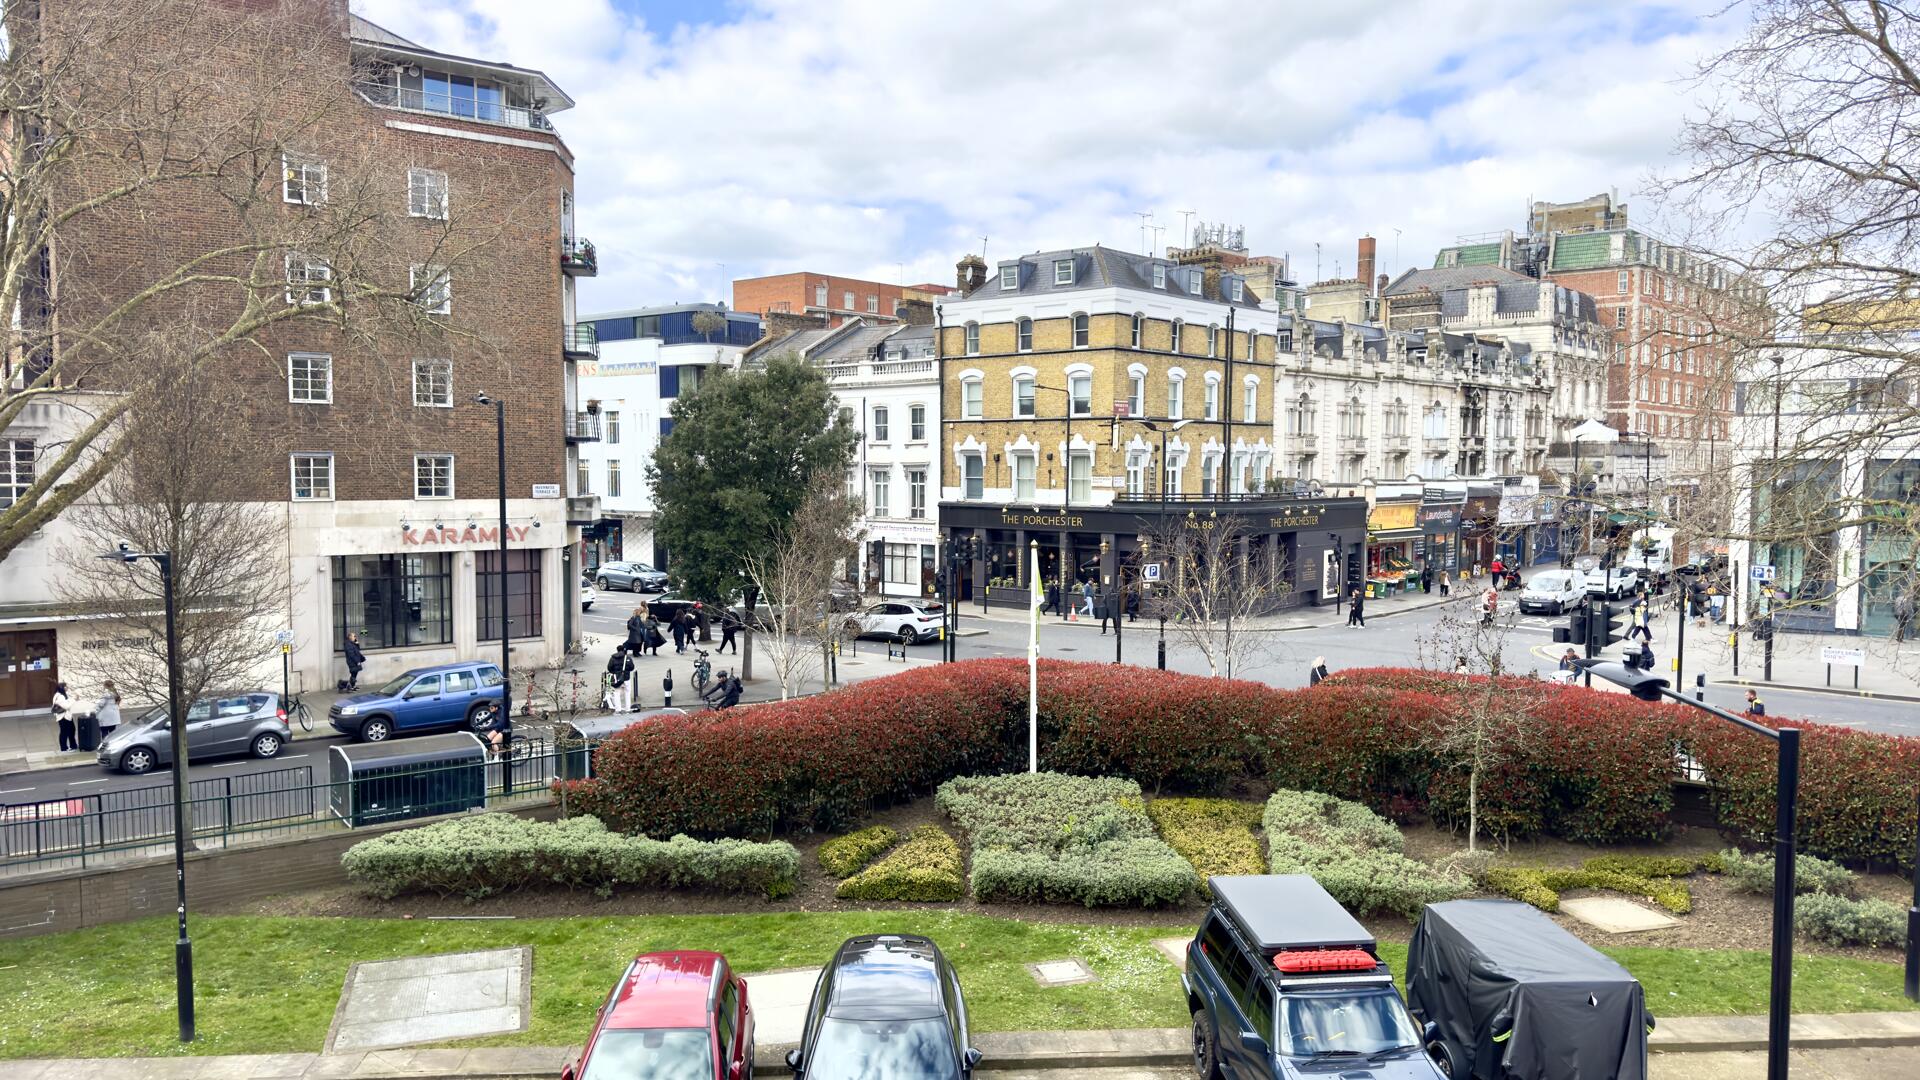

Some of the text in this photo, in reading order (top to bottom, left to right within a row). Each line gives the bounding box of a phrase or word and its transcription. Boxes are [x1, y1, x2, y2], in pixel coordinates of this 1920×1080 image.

[1001, 514, 1083, 527] THE PORCHESTER
[1202, 520, 1214, 529] 88
[1270, 516, 1319, 528] THE PORCHESTER
[402, 526, 530, 545] KARAMAY
